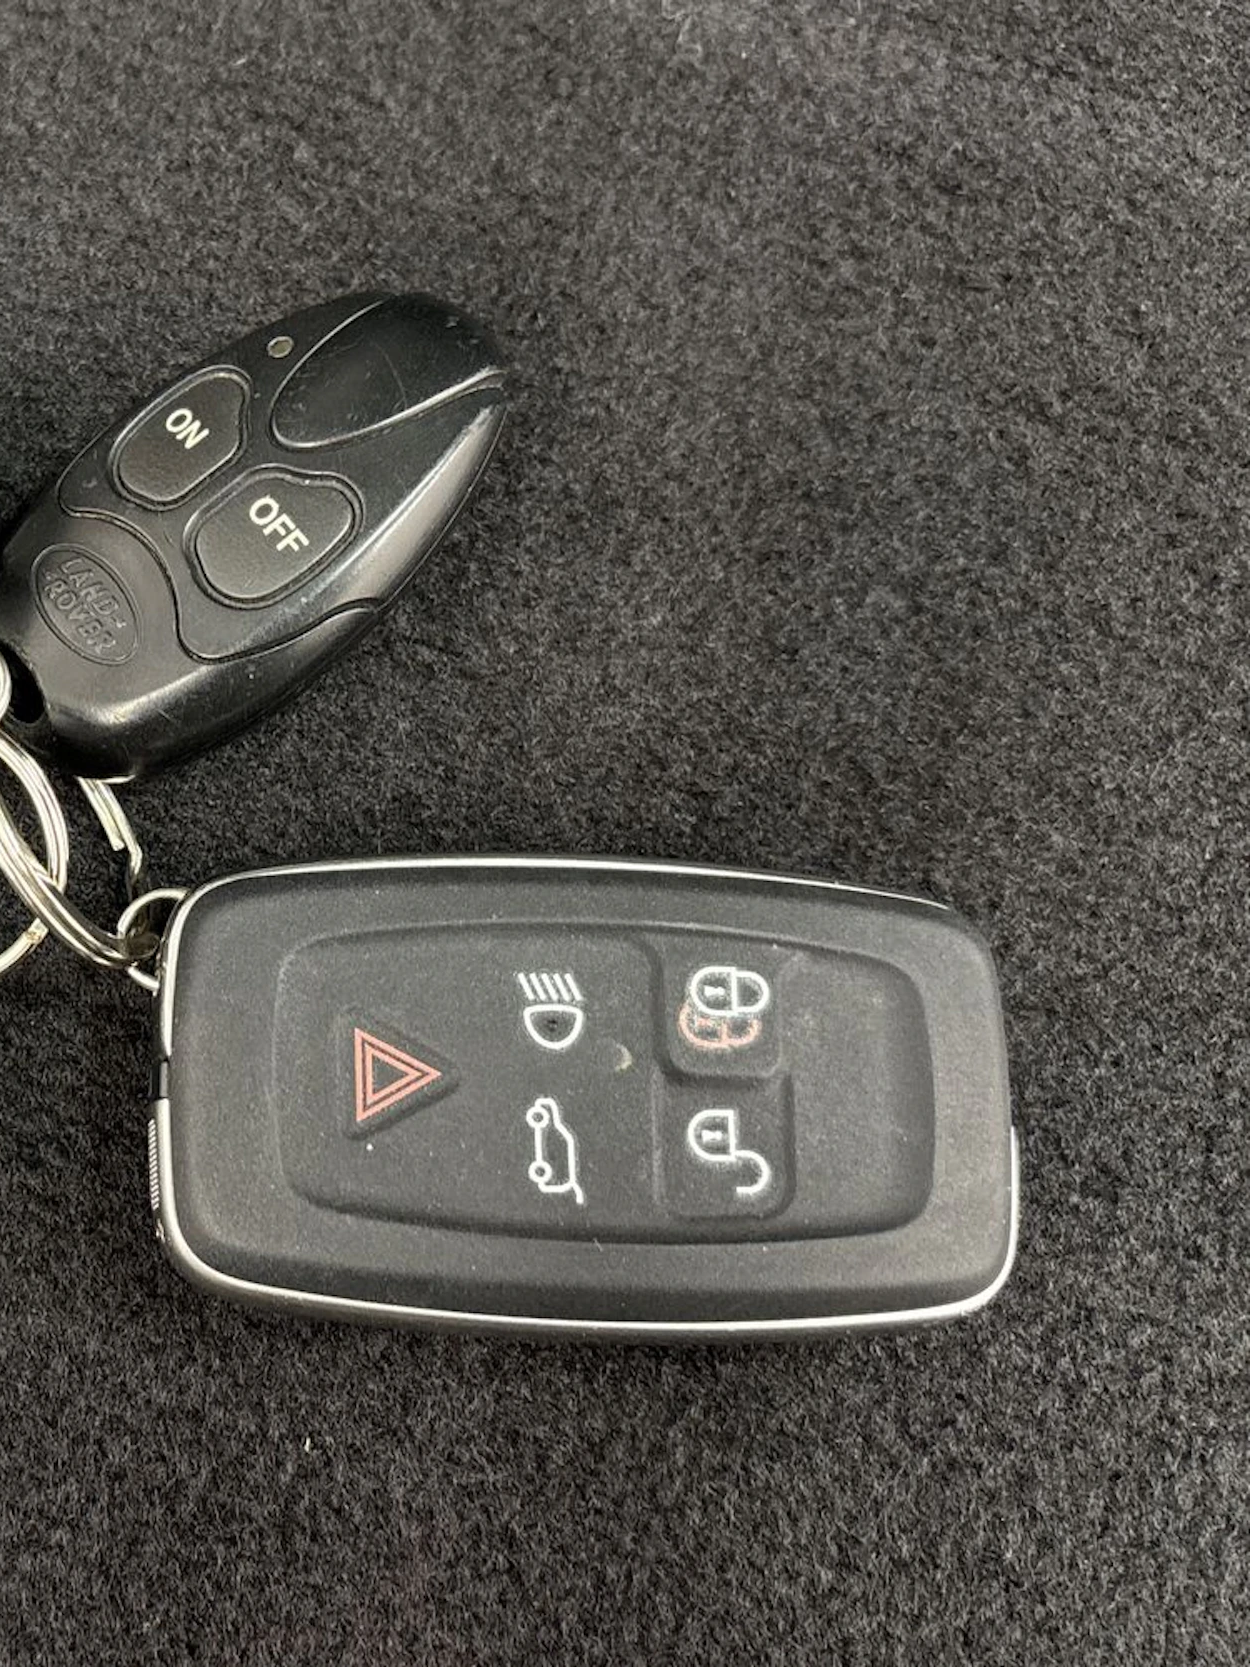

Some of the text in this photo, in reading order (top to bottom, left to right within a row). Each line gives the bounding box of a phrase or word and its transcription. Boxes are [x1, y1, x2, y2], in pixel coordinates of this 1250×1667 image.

[164, 407, 211, 451] ON
[247, 493, 311, 554] OFF
[43, 577, 117, 655] ROVER
[60, 557, 119, 616] LAND
